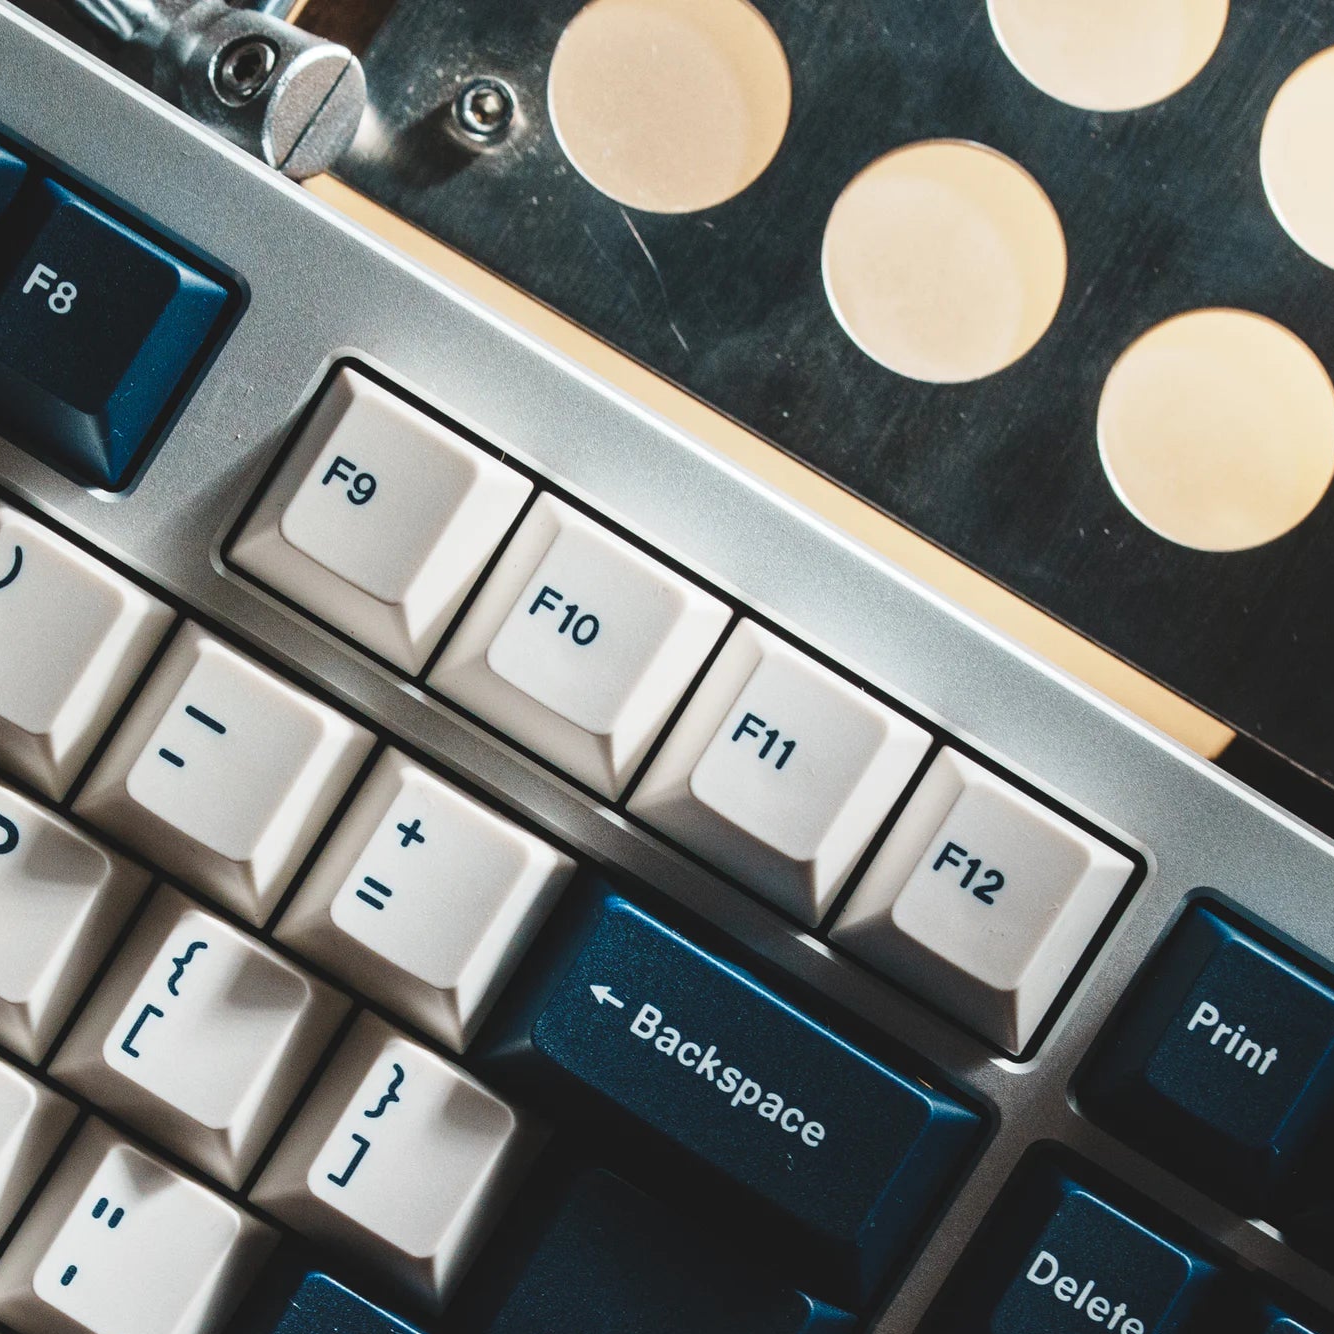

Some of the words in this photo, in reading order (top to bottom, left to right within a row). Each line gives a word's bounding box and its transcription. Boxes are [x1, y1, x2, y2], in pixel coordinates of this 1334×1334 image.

[22, 263, 78, 314] F8
[321, 455, 377, 506] F9
[528, 585, 600, 646] F10
[731, 712, 797, 771] F11
[396, 819, 426, 848] +
[355, 876, 393, 911] =
[932, 841, 1005, 906] F12
[167, 941, 209, 997] {
[120, 1003, 165, 1059] [
[1187, 1001, 1278, 1075] Print
[363, 1063, 405, 1119] }
[629, 1003, 826, 1147] Backspace
[326, 1133, 371, 1188] ]
